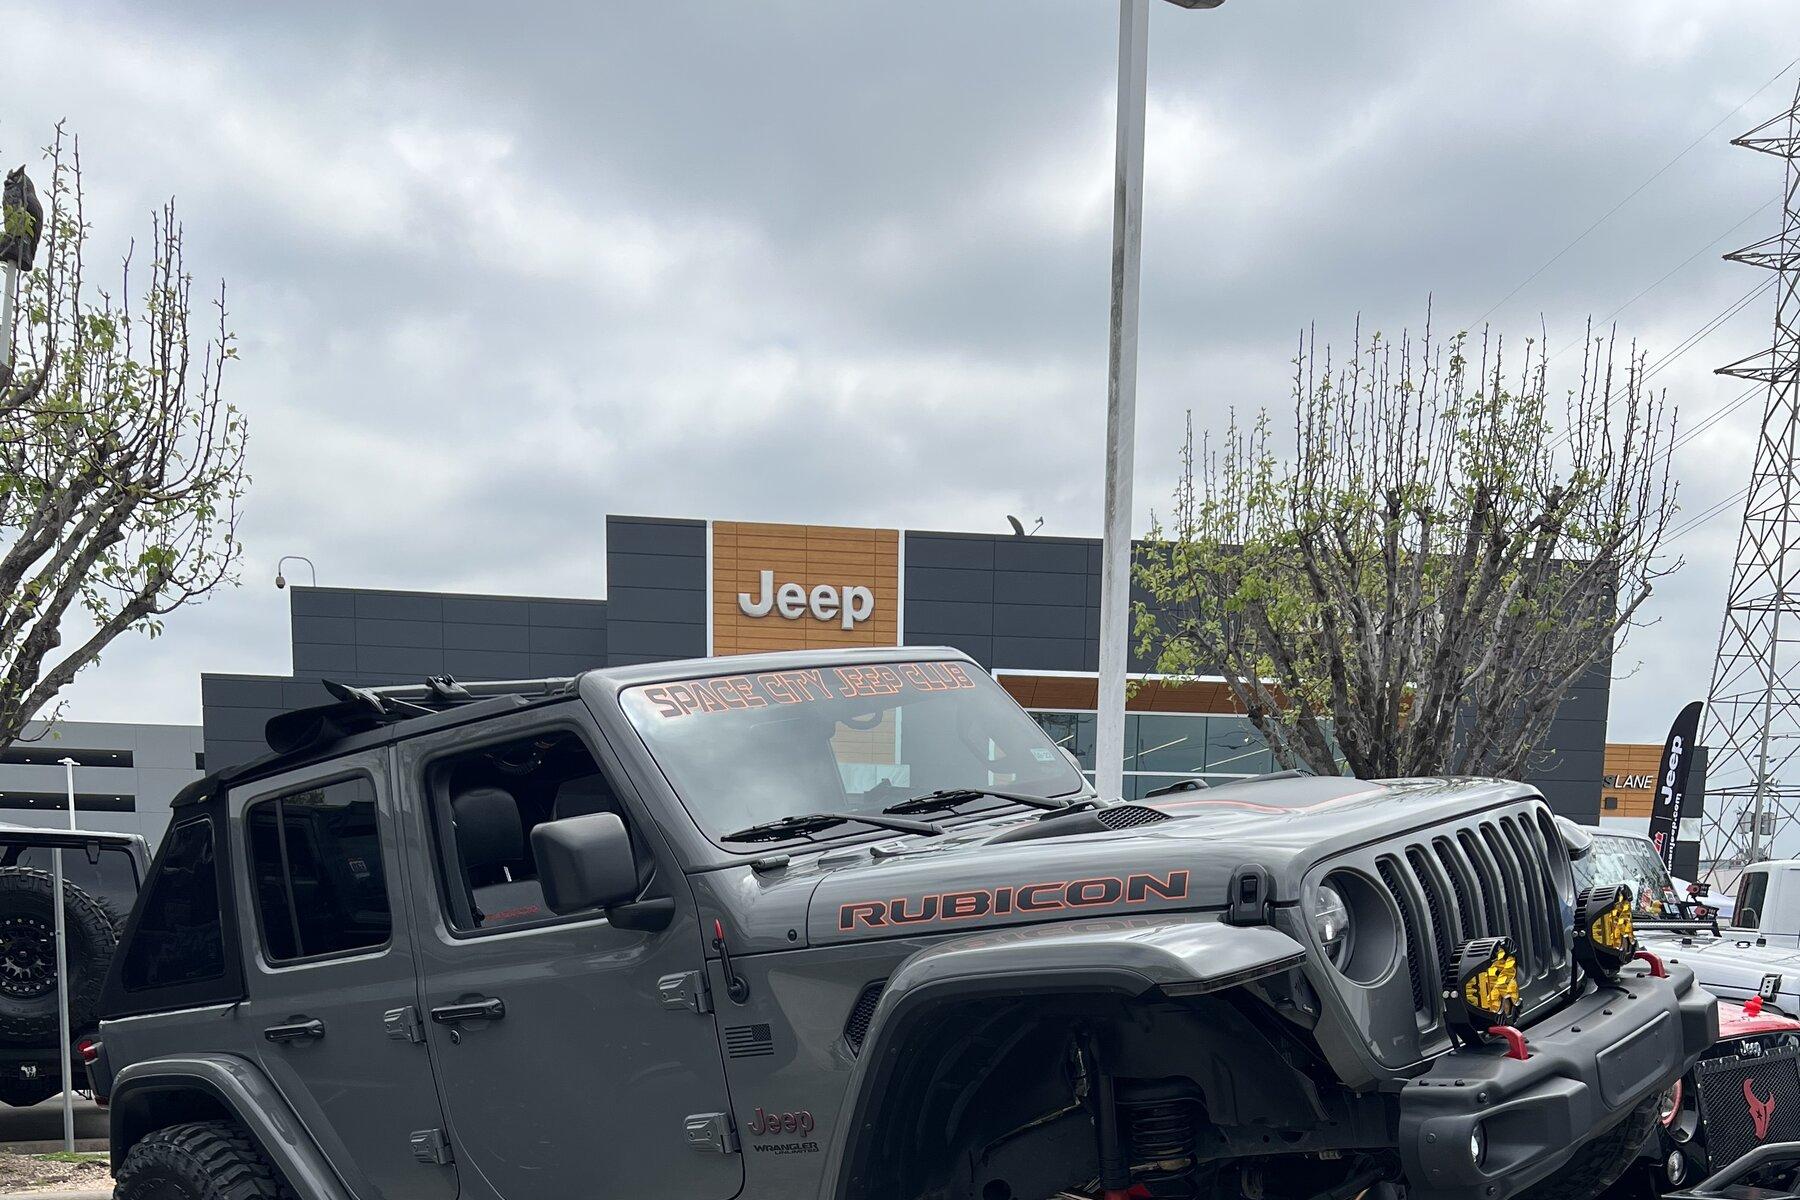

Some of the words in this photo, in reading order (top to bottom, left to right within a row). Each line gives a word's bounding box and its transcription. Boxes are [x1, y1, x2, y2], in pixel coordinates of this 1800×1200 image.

[738, 570, 874, 630] Jeep
[645, 678, 767, 718] SPACE
[757, 669, 834, 704] CITY
[834, 665, 903, 697] JEEP
[899, 663, 976, 691] CLUB
[1615, 774, 1653, 789] LANE
[1661, 735, 1684, 805] Jeep
[839, 871, 1190, 931] RUBICON
[747, 1107, 814, 1138] Jeep
[754, 1142, 819, 1153] WRANGLER
